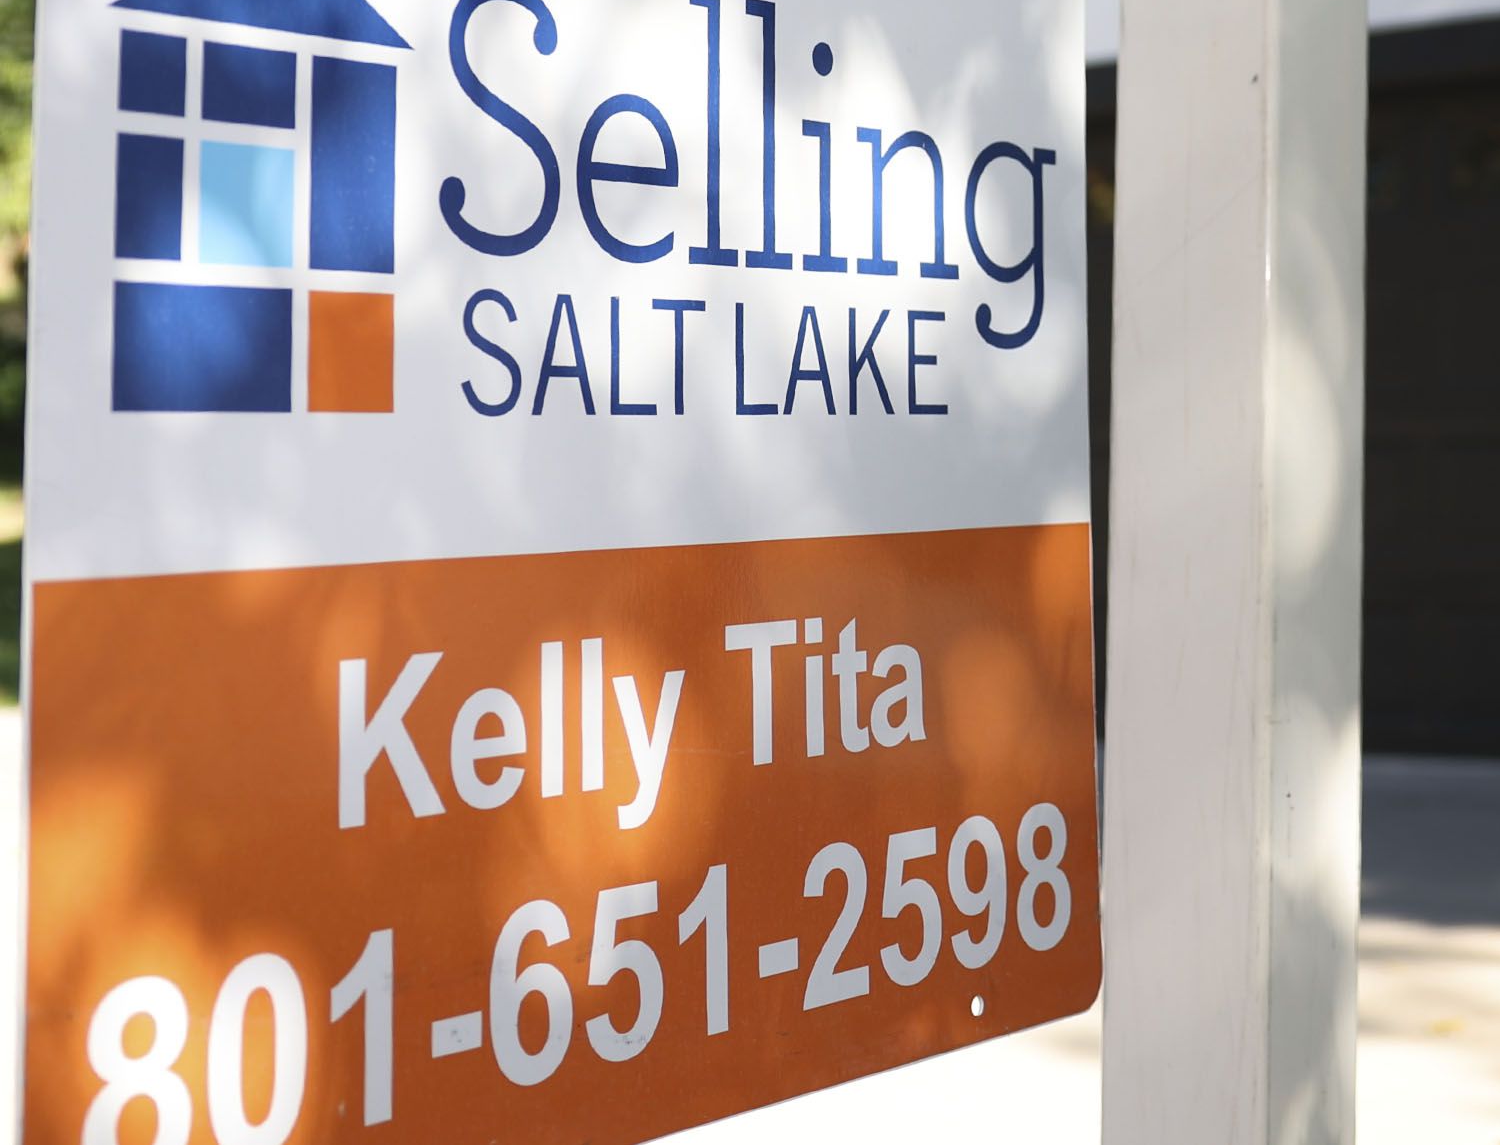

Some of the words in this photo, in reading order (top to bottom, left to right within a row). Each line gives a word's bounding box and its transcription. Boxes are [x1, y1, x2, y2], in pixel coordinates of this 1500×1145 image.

[461, 288, 706, 417] SALT
[735, 304, 949, 417] LAKE
[337, 637, 686, 831] Kelly
[725, 617, 927, 766] Tita
[80, 802, 1073, 1145] 801-651-2598
